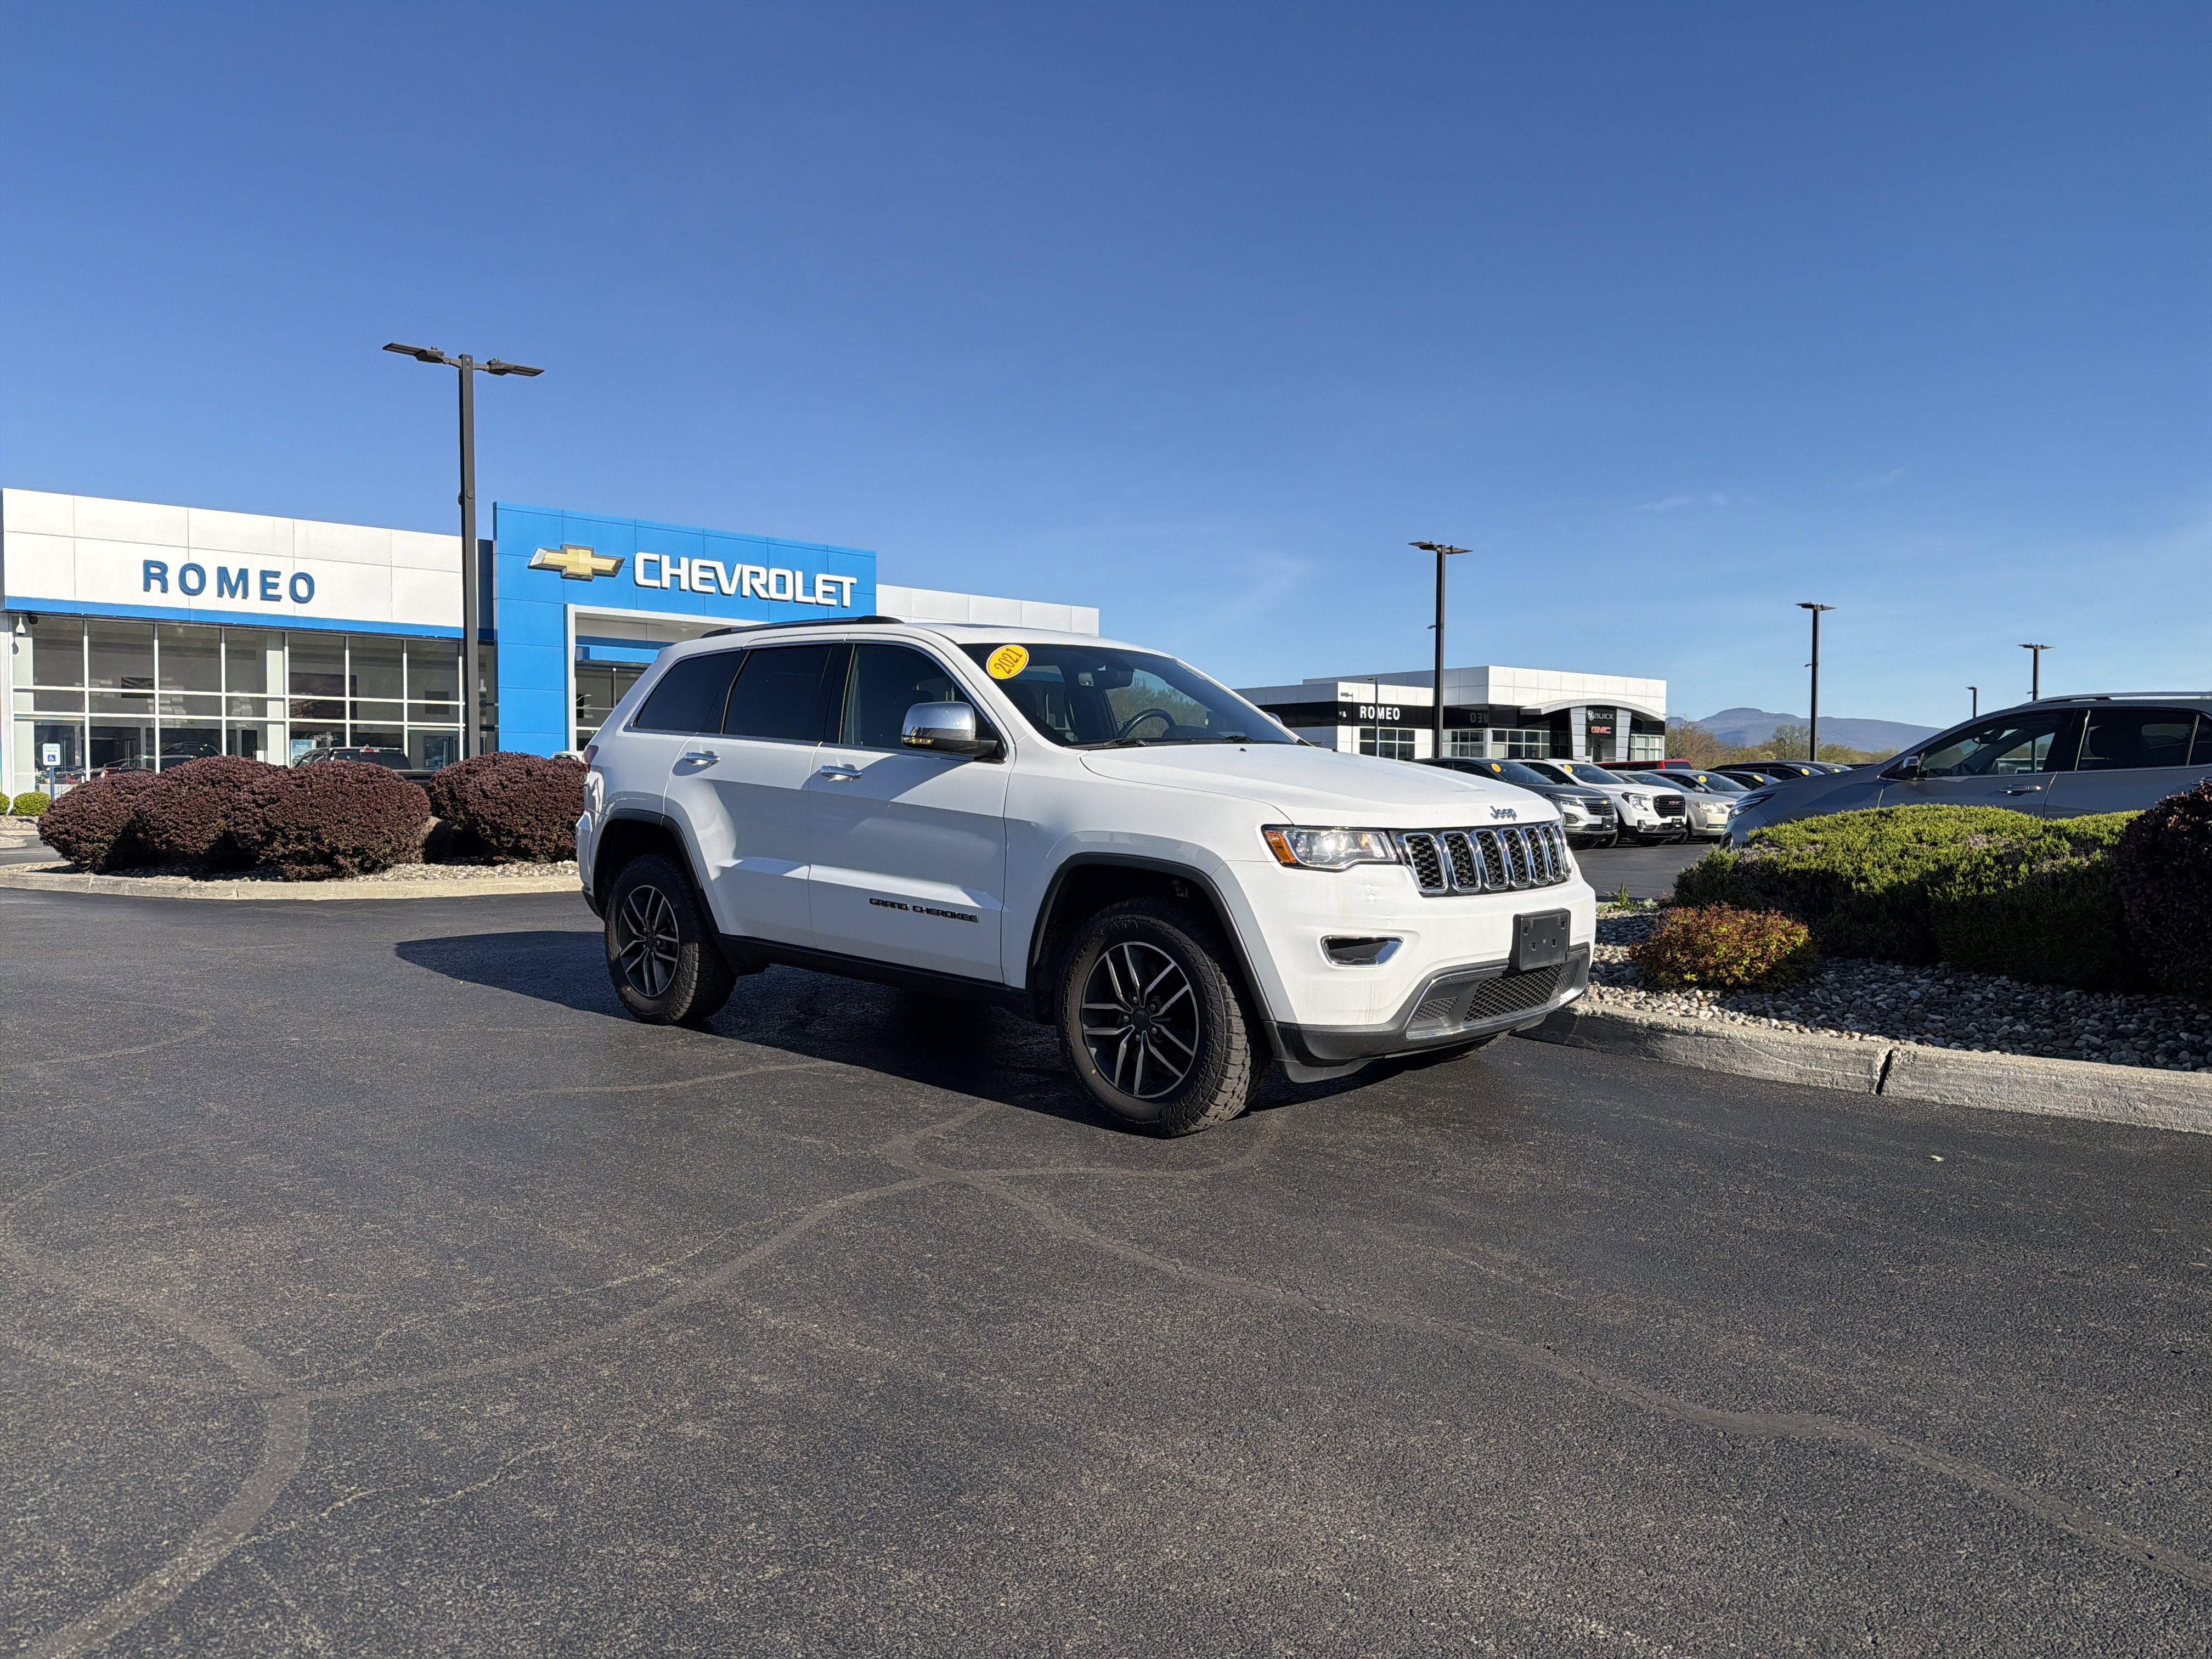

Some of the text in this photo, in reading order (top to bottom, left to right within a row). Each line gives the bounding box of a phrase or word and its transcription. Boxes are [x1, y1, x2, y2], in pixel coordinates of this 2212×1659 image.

[143, 560, 315, 604] ROMEO
[635, 552, 857, 608] CHEVROLET
[994, 648, 1023, 674] 2021
[1360, 706, 1400, 720] ROMEO
[1591, 726, 1611, 734] GMC
[1489, 805, 1517, 821] Jeep
[870, 898, 979, 923] GRAND CHEROKEE
